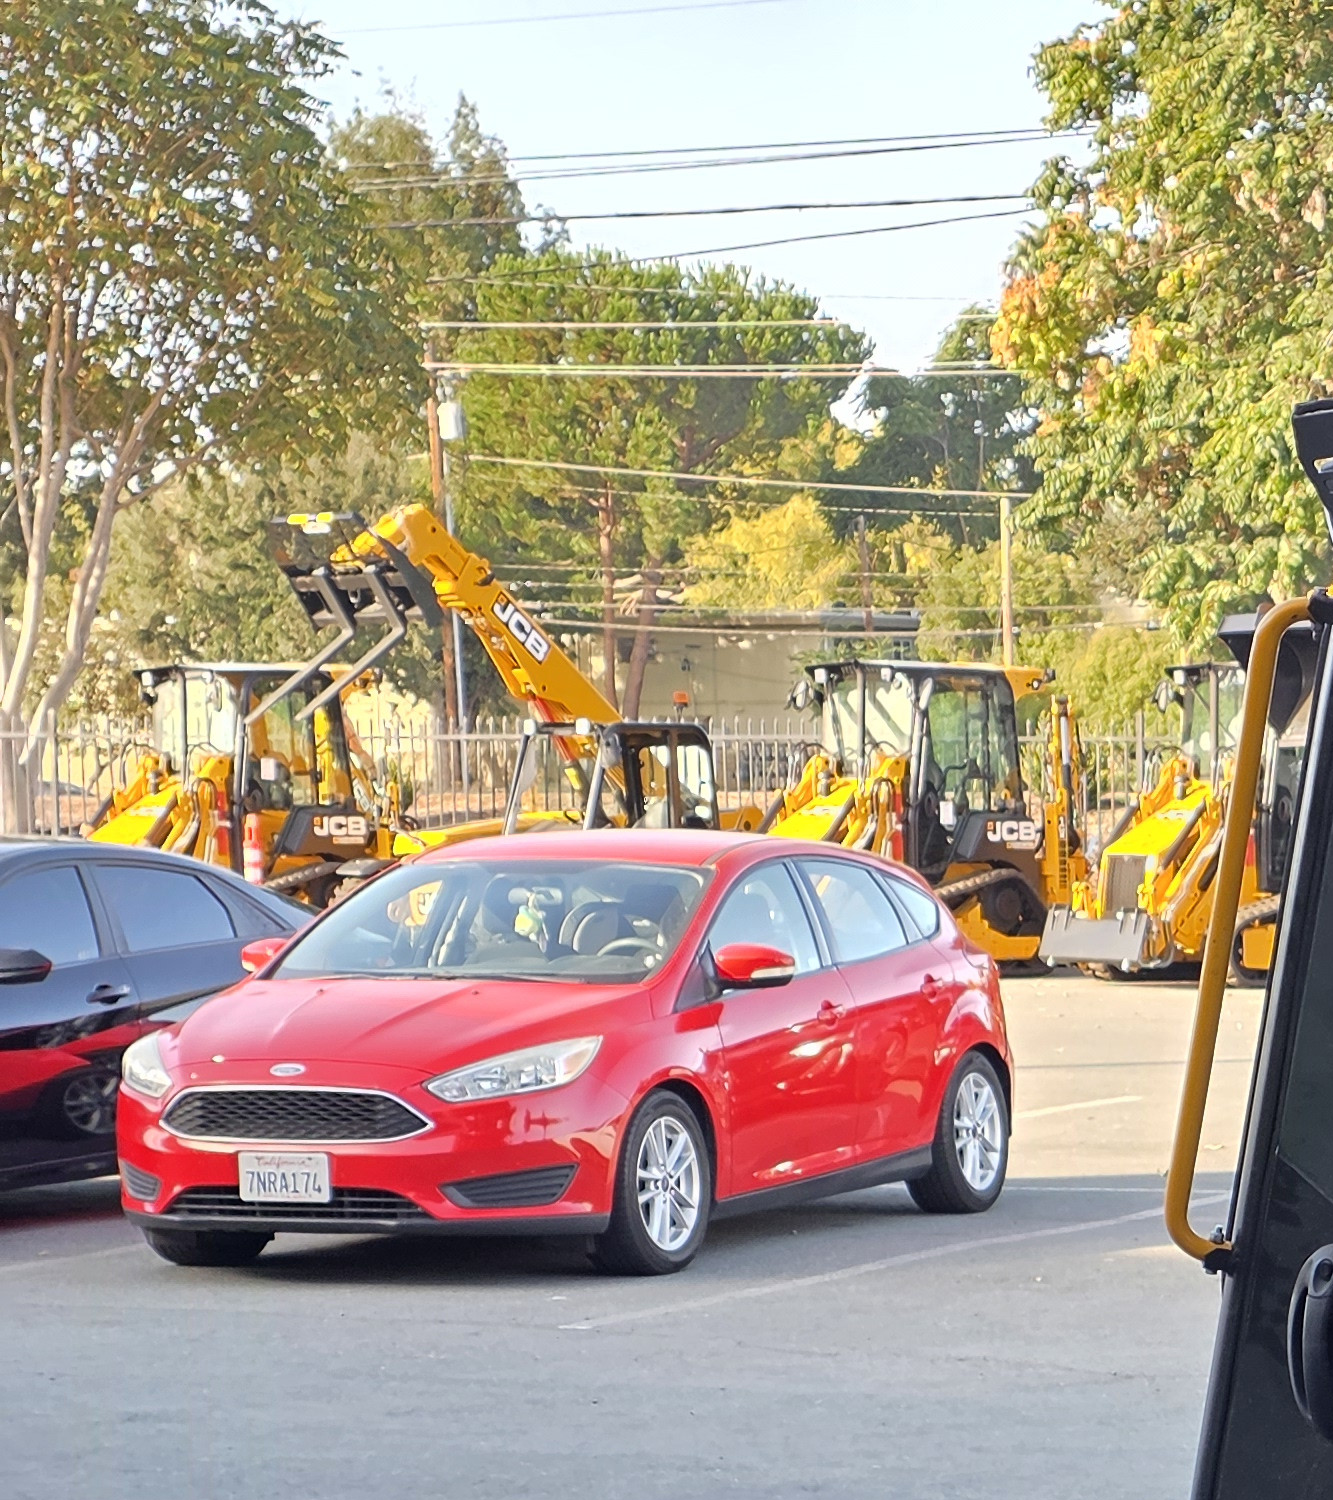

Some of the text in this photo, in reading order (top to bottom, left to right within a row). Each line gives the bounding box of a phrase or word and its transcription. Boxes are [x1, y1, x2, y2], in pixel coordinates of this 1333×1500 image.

[493, 602, 550, 662] JCB
[314, 815, 367, 836] JCB
[987, 820, 1036, 842] JCB
[245, 1170, 322, 1195] 7NRA174
